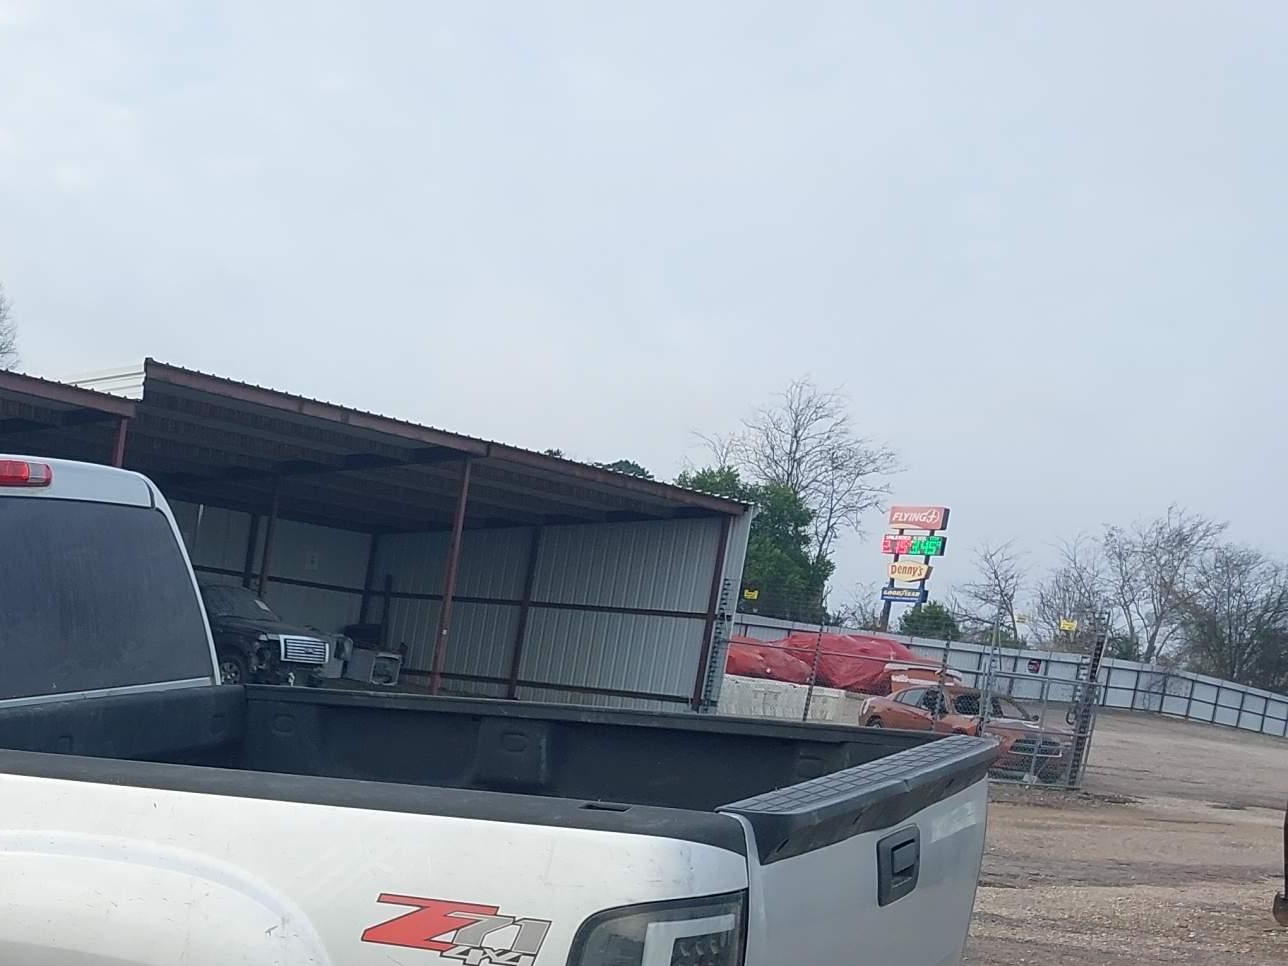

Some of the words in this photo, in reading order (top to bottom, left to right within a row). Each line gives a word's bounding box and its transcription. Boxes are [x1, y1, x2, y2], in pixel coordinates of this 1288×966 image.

[892, 510, 927, 523] FLYING
[890, 564, 924, 577] Denny's
[360, 892, 553, 955] Z71
